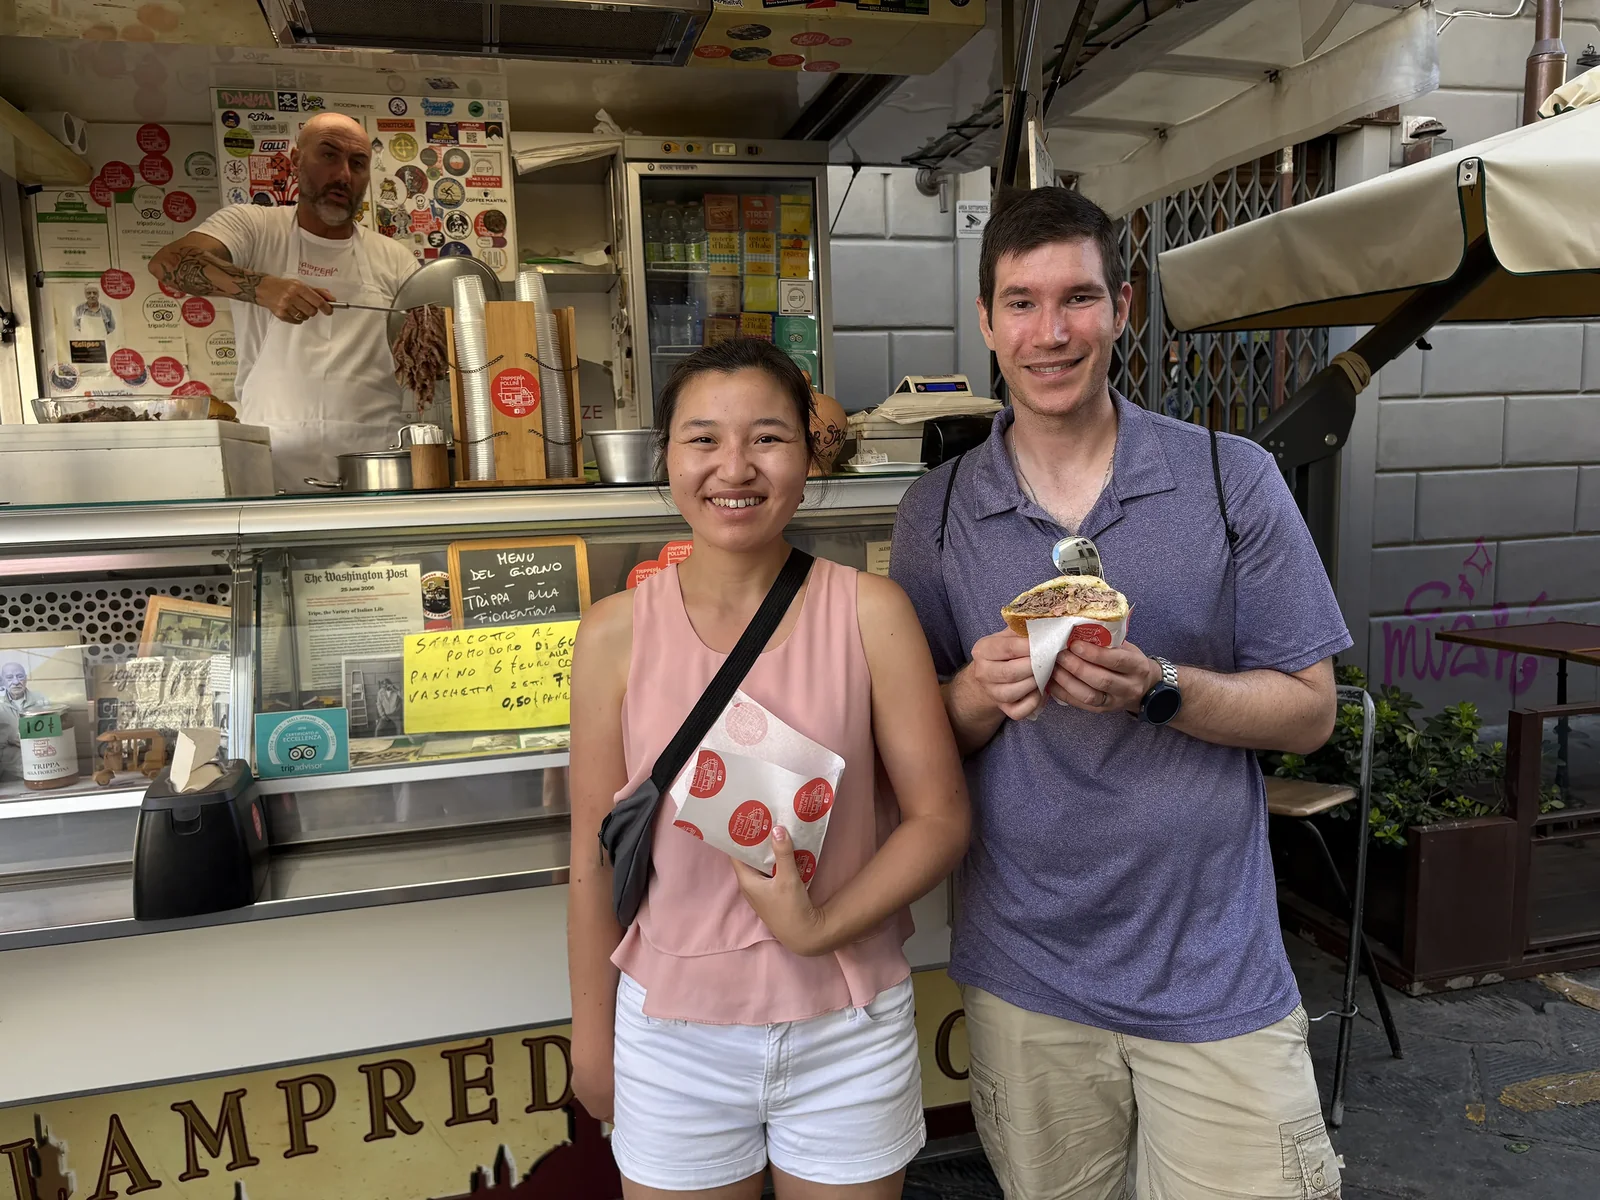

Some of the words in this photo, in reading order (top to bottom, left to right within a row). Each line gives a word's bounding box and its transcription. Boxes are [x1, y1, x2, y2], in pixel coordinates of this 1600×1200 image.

[497, 552, 535, 565] MENU
[304, 573, 322, 584] The
[324, 570, 384, 582] Washington
[385, 568, 409, 581] Post
[470, 569, 495, 581] DEL
[415, 631, 516, 655] STRACOTTO
[446, 643, 522, 662] POMODORO
[409, 684, 494, 703] VASCHETTA
[282, 735, 322, 743] ECCELLENZA
[32, 761, 60, 770] TRIPPA
[281, 763, 324, 773] tripadvisor
